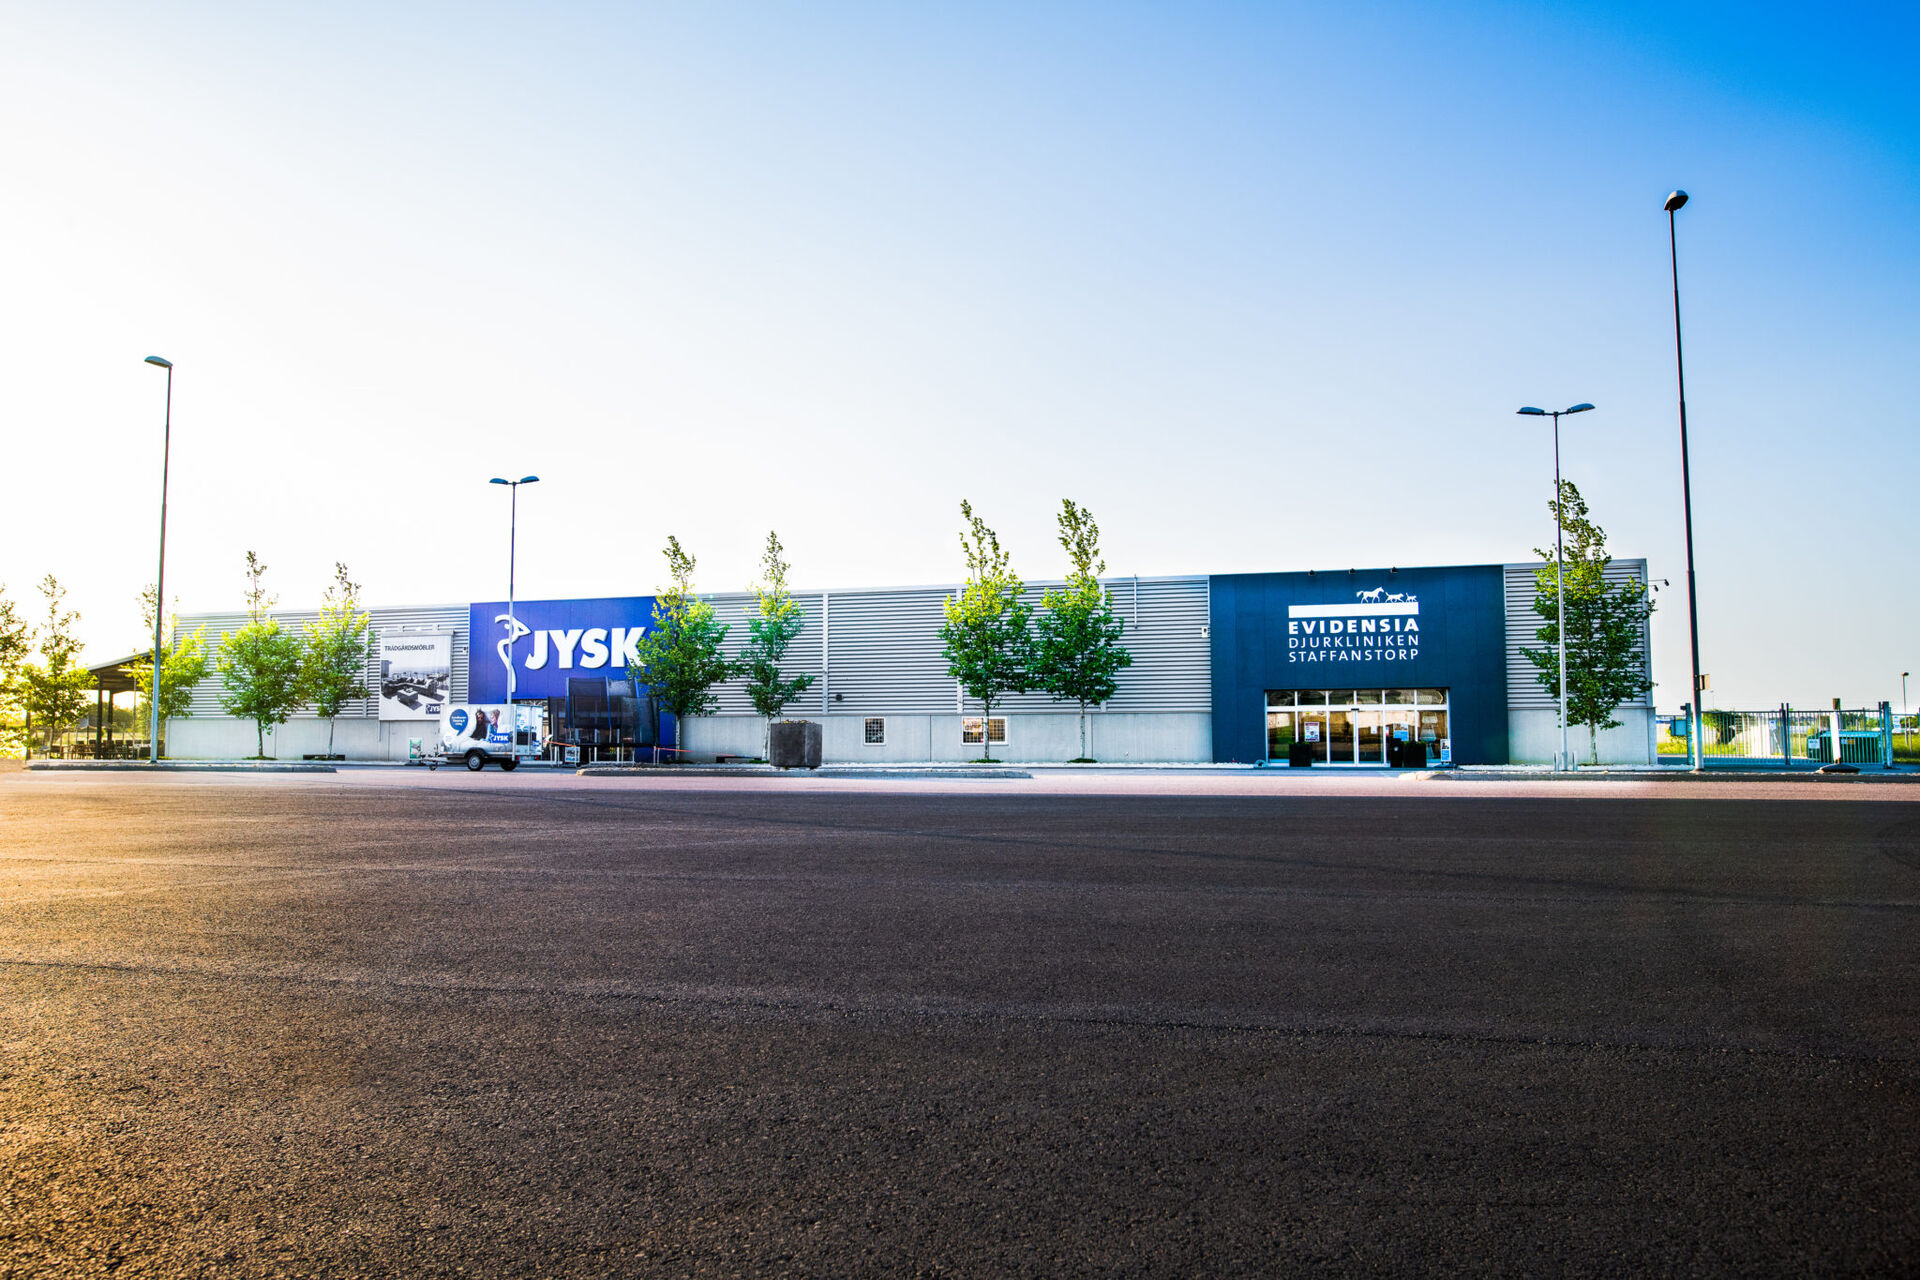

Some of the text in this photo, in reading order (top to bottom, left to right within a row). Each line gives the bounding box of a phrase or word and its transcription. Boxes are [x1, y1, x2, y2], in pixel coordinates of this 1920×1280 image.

[1288, 618, 1420, 635] EVIDENSIA
[384, 644, 435, 652] TRÄDGÅRDSMÖBLER
[524, 626, 648, 670] JYSK
[1288, 634, 1420, 649] DJURKLINIKEN
[1288, 648, 1420, 663] STAFFANSTORP
